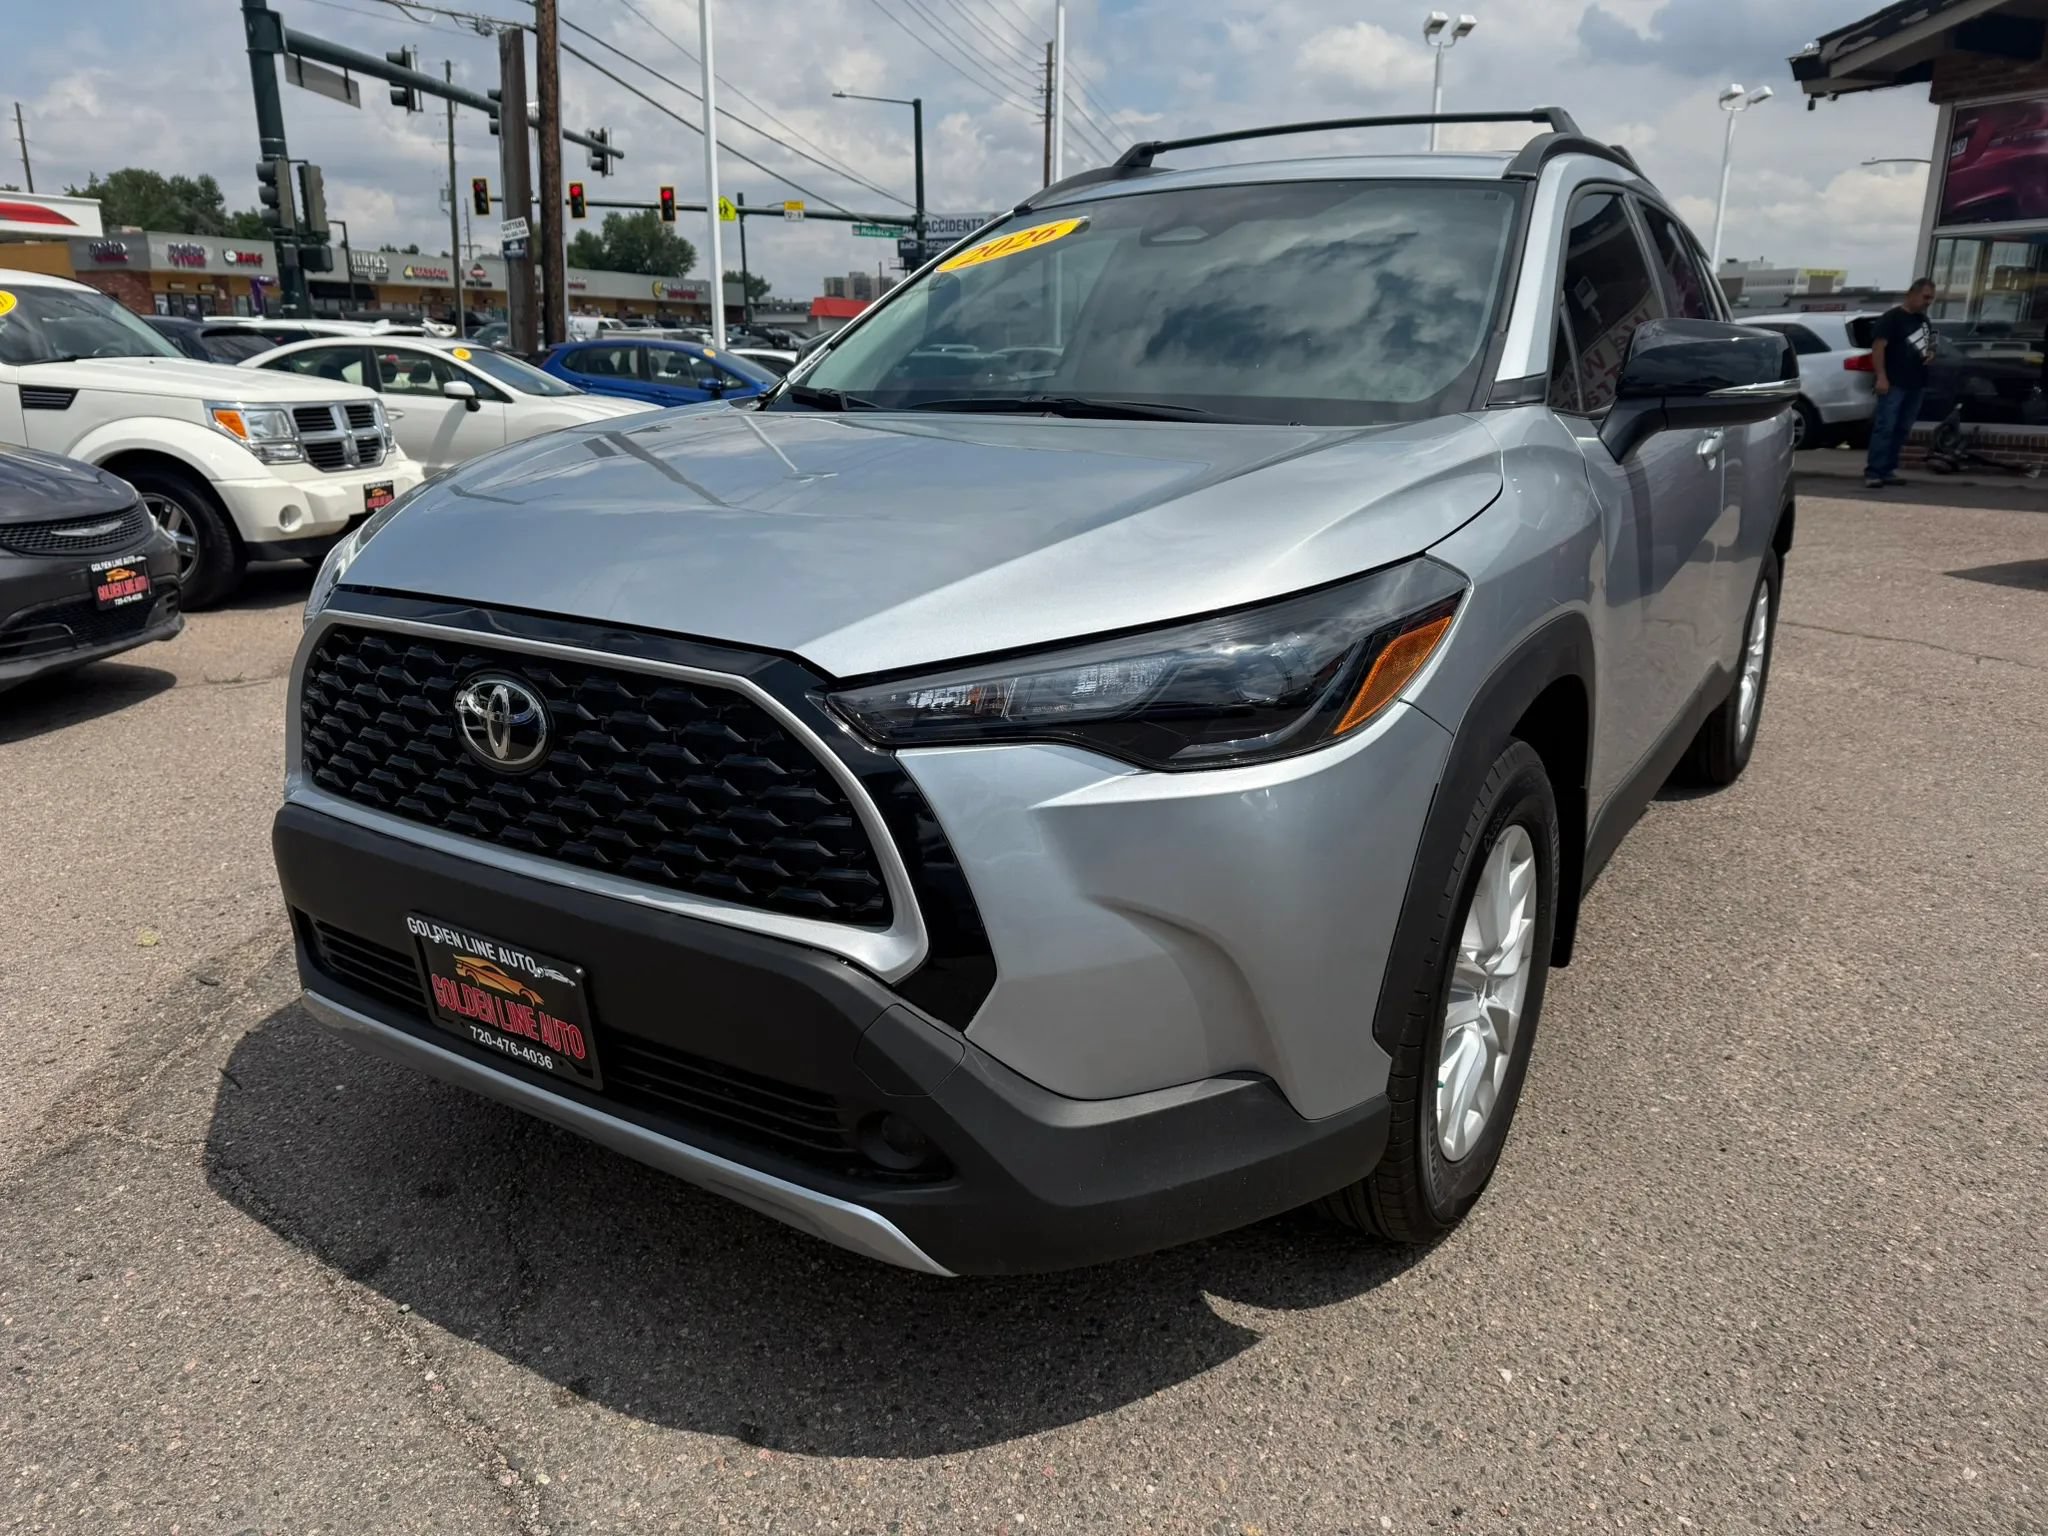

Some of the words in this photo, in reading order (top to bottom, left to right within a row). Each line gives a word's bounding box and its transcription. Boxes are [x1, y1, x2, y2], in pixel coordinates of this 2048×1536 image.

[955, 223, 1065, 267] 2026
[91, 562, 112, 572] GOLDEN
[97, 582, 123, 601] GOLDEN
[407, 917, 462, 949] GOLDEN
[463, 935, 497, 961] LINE
[499, 947, 538, 974] AUTO
[431, 973, 498, 1027] GOLDEN
[496, 996, 540, 1041] LINE
[540, 1011, 587, 1060] AUTO
[469, 1025, 554, 1070] 720-476-4036
